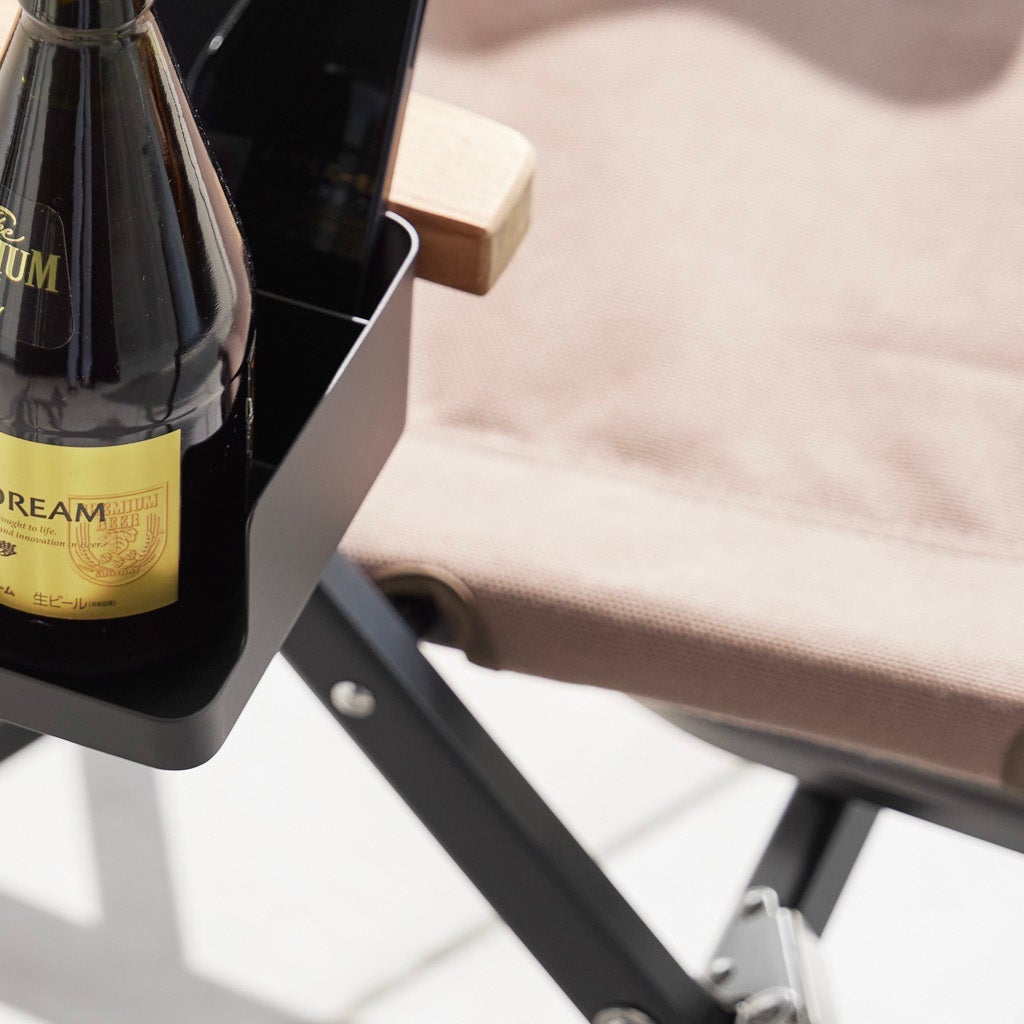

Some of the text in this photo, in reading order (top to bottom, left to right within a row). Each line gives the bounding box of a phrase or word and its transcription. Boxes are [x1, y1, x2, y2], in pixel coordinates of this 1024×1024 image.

[28, 523, 38, 533] to
[16, 532, 66, 548] innovation
[32, 591, 89, 610] 生ビール
